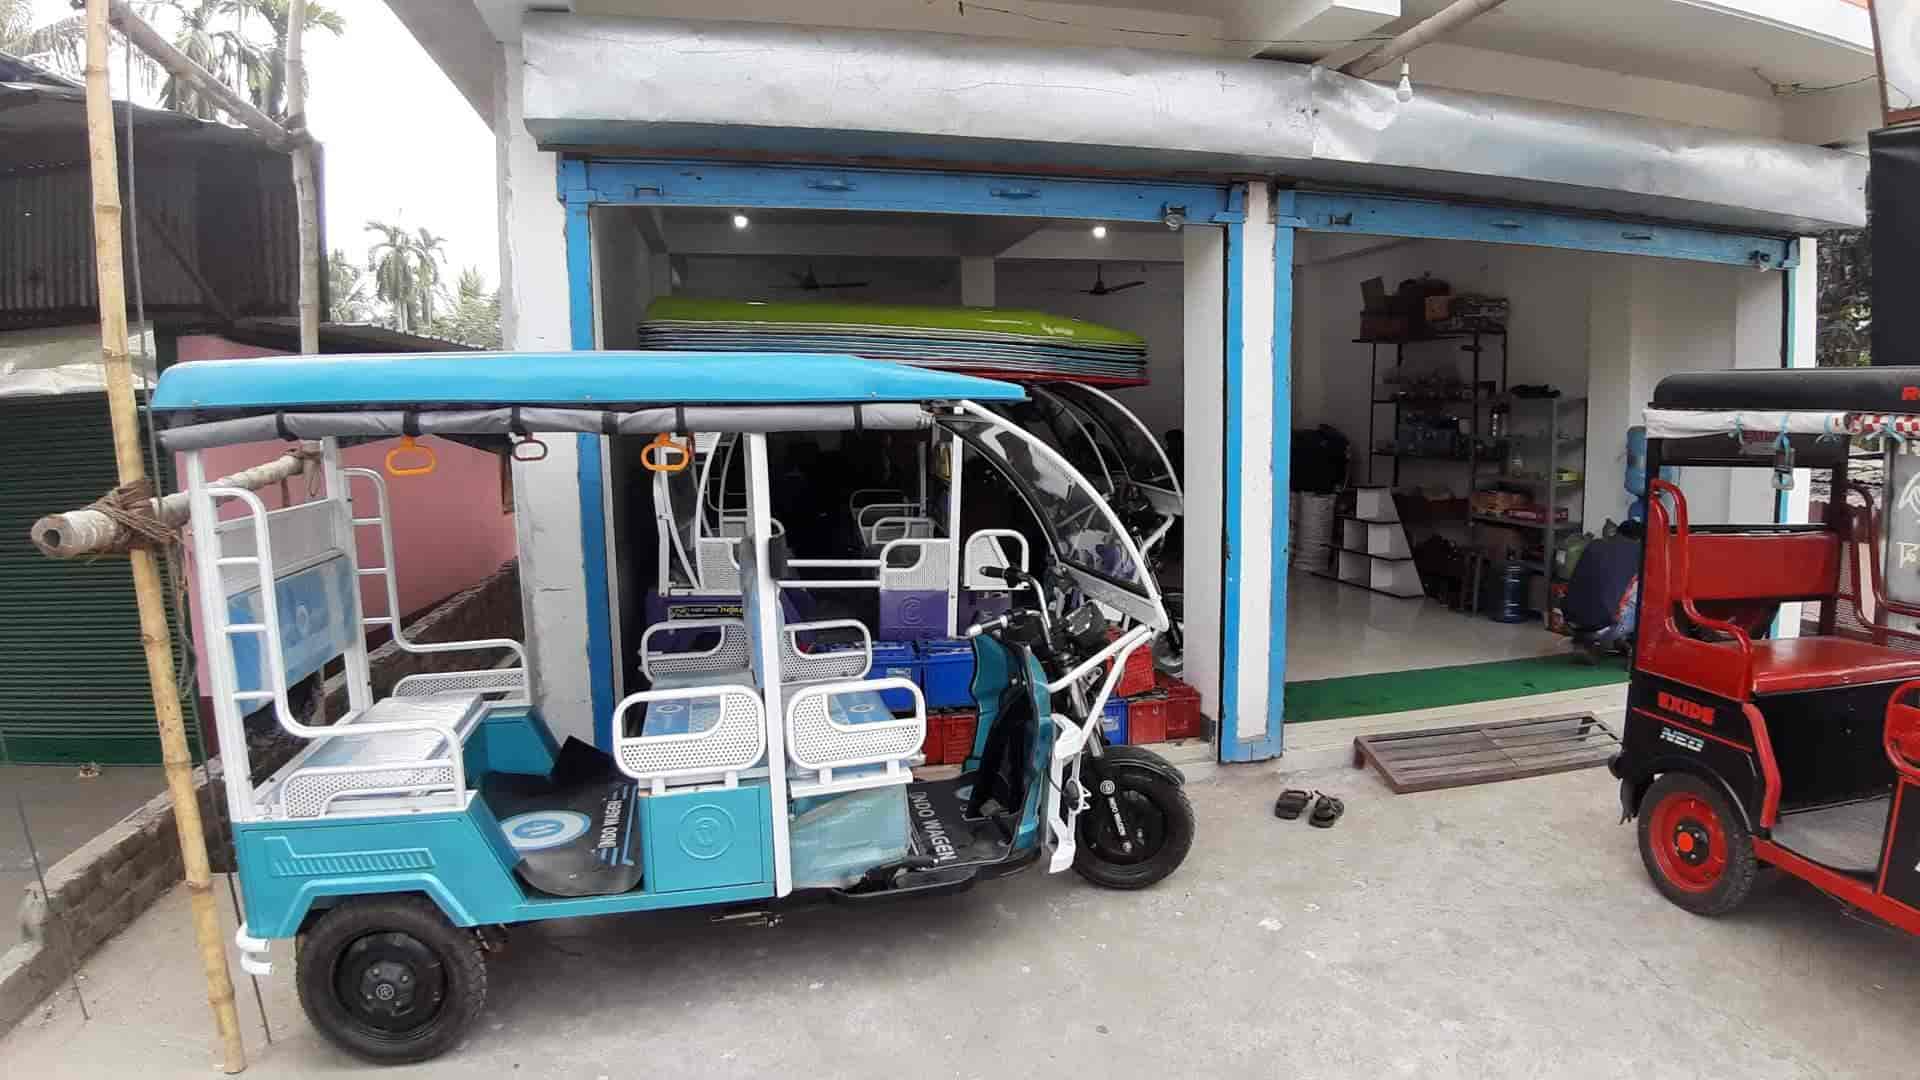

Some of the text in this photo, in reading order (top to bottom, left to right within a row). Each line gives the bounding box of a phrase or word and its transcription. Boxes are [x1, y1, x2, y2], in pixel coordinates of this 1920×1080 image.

[1658, 692, 1715, 725] EXIDE
[598, 800, 623, 849] INDO WAGEN
[922, 819, 958, 861] WAGEN
